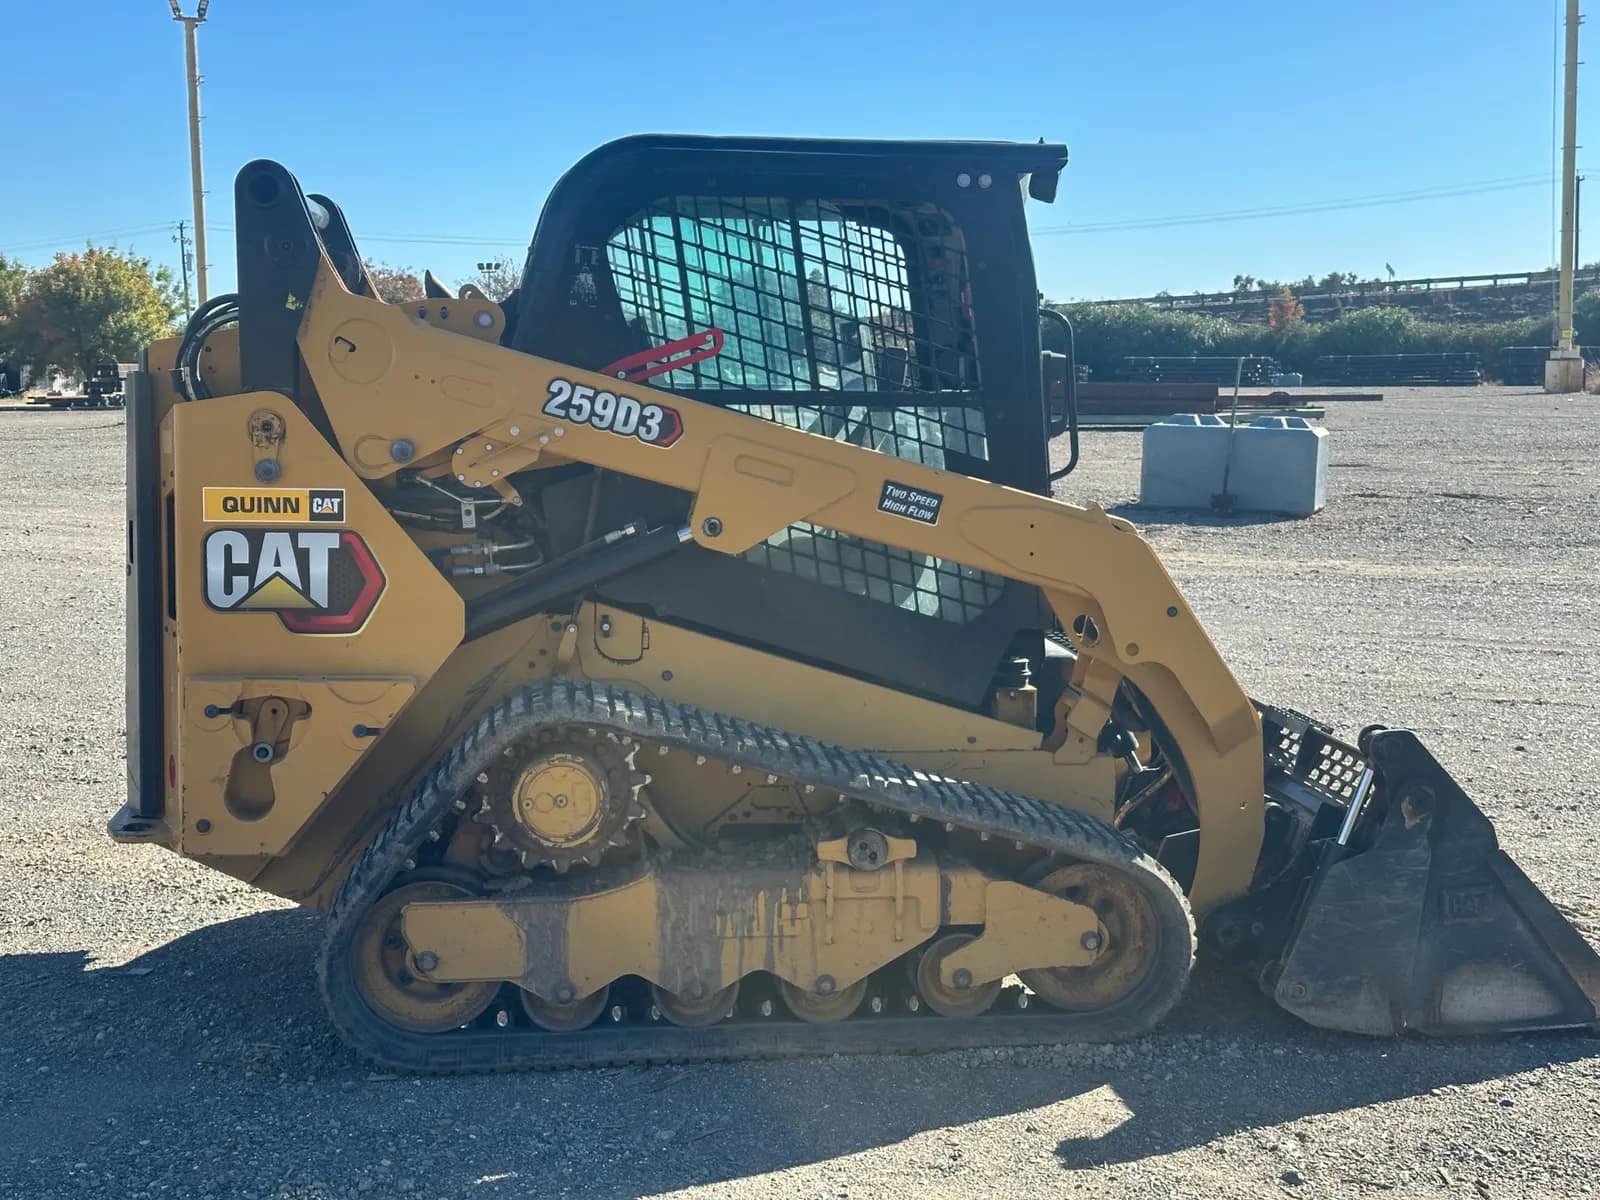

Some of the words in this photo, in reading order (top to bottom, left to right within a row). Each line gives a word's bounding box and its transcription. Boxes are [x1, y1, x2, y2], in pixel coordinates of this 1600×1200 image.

[544, 379, 663, 441] 259D3
[222, 496, 300, 513] QUINN
[312, 497, 341, 514] CAT
[886, 485, 907, 499] TWO
[908, 491, 938, 508] SPEED
[882, 498, 907, 513] HIGH
[907, 505, 934, 520] FLOW
[206, 530, 340, 608] CAT
